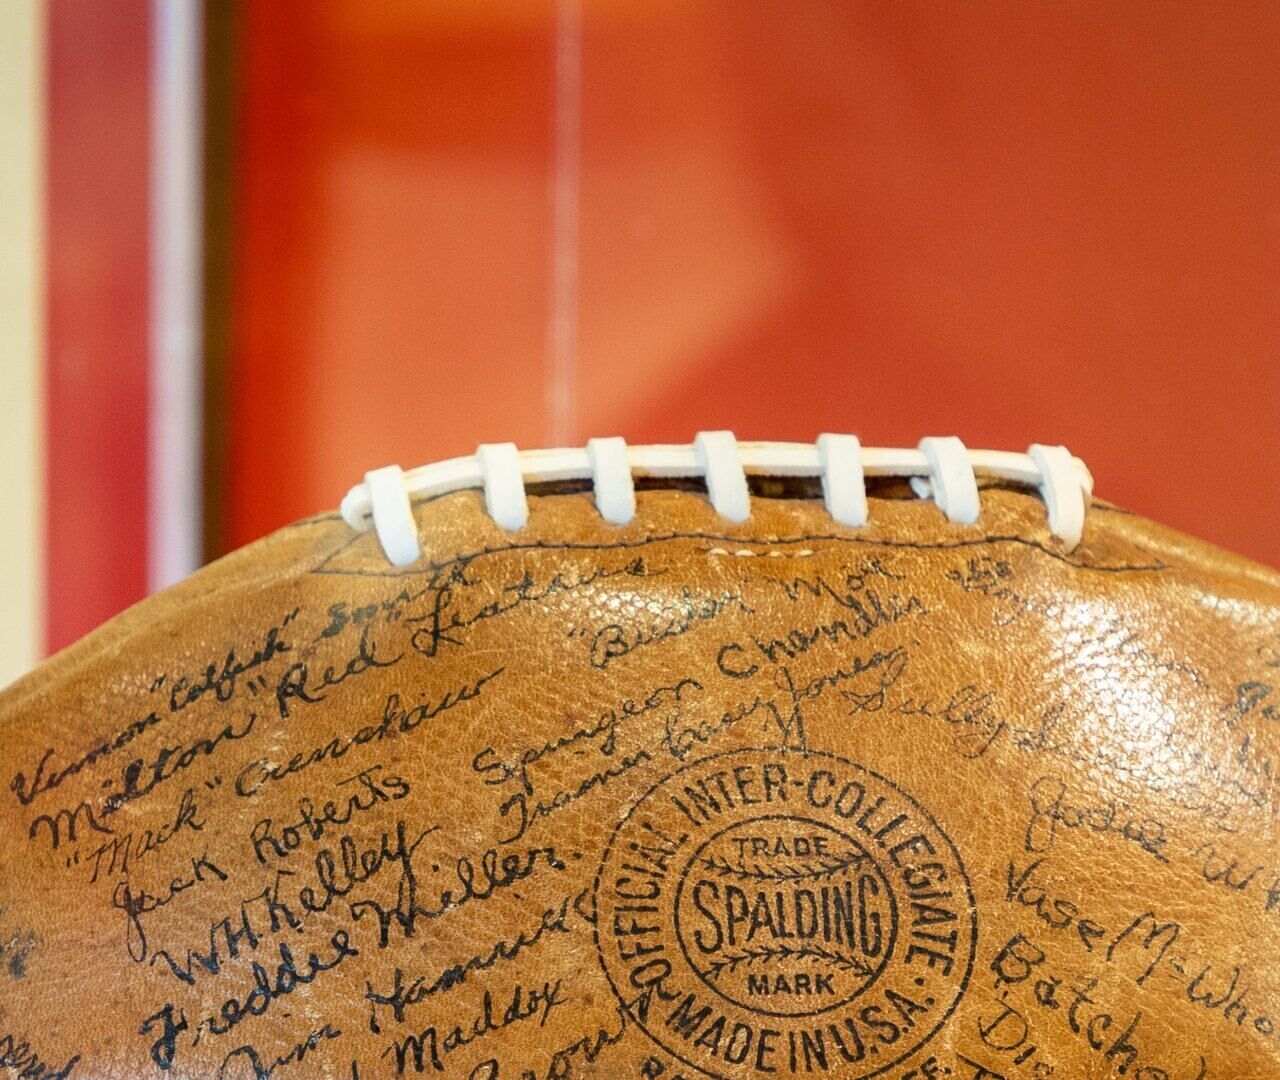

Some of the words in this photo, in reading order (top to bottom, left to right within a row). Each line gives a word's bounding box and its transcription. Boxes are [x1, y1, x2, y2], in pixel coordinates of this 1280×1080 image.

[29, 714, 255, 851] Milton
[112, 850, 228, 963] Jack
[249, 764, 410, 866] Roberts
[732, 836, 830, 859] TRADE
[614, 824, 690, 995] OFFICIAL
[692, 873, 884, 957] SPALDING
[138, 928, 360, 1071] Freddie
[382, 979, 569, 1075] Maddox
[747, 972, 836, 996] MARK
